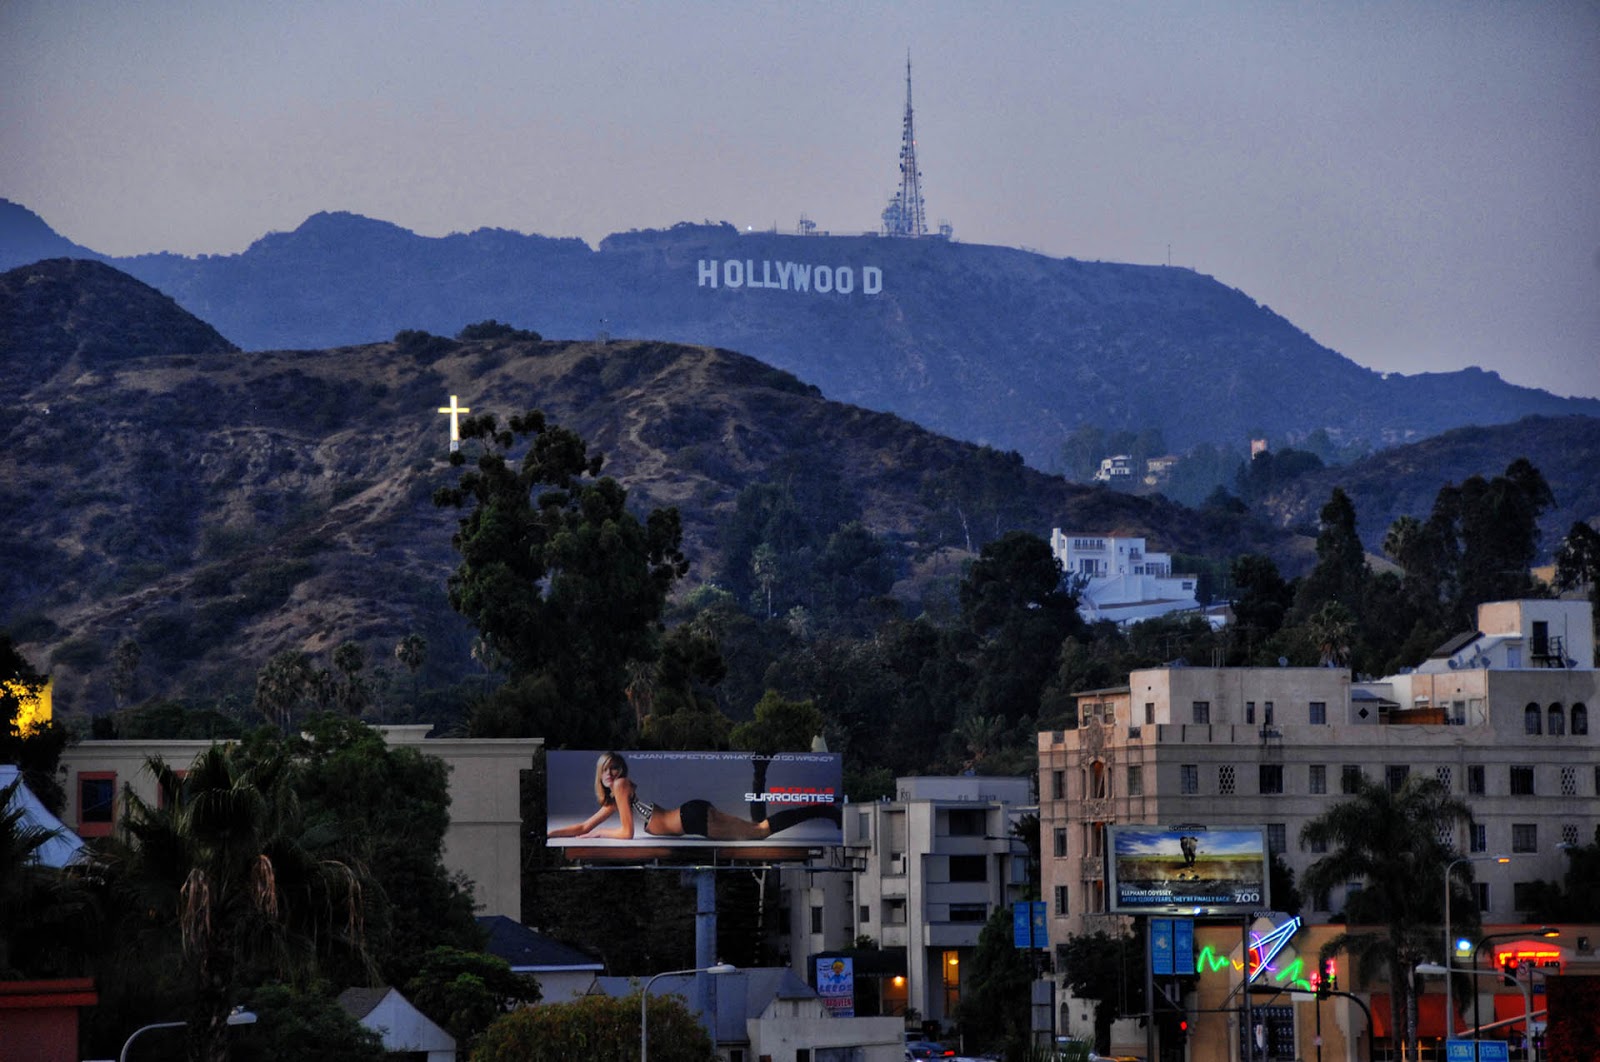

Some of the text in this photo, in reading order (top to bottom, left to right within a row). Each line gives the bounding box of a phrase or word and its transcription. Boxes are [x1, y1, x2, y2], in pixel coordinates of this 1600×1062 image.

[698, 259, 882, 295] HOLLYWOOD
[744, 792, 834, 803] SURROGATES
[1235, 893, 1260, 903] ZOO
